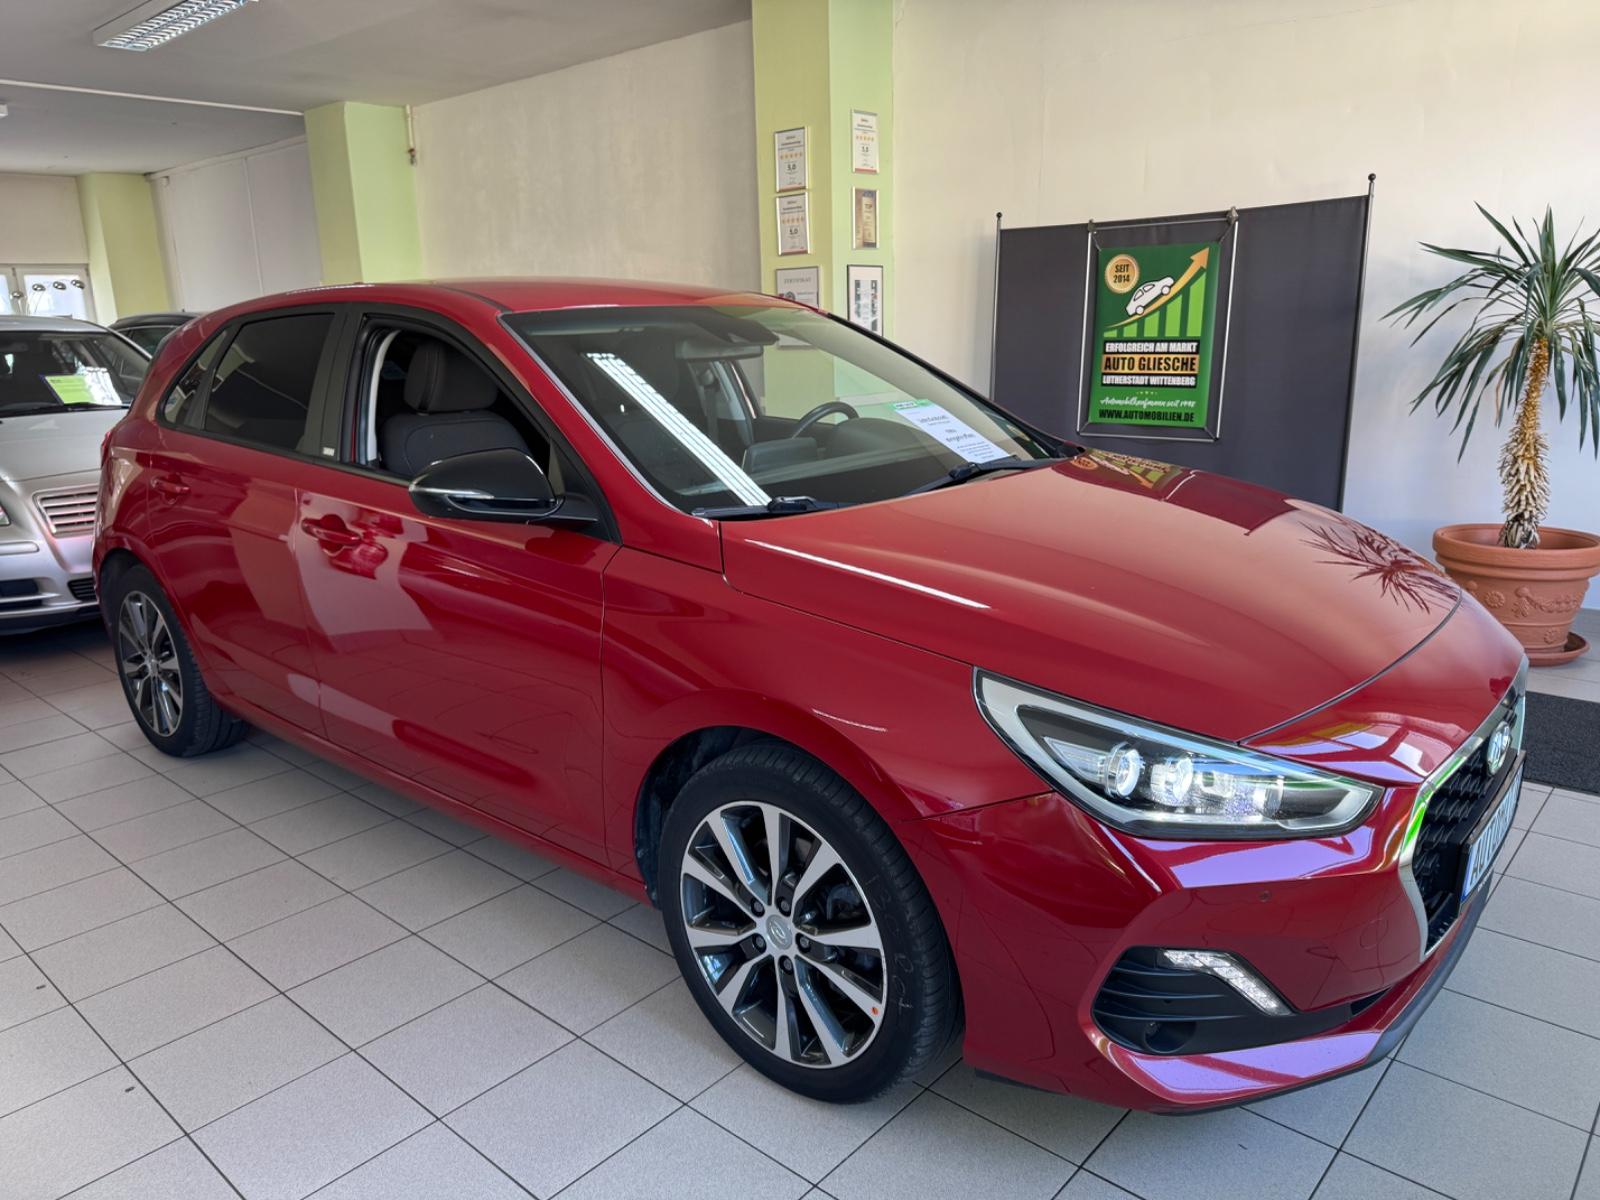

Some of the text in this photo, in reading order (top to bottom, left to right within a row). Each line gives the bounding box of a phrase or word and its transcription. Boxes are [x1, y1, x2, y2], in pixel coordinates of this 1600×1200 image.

[1114, 263, 1130, 273] SEIT
[1113, 274, 1130, 284] 2014
[1105, 342, 1198, 352] ERFOLGREICH AM MARKT
[1104, 356, 1197, 372] AUTO GLIESCHE
[1102, 375, 1196, 386] LUTHERSTADT WITTENBERG
[1098, 408, 1195, 422] WWW.AUTOMOBILIEN.DE
